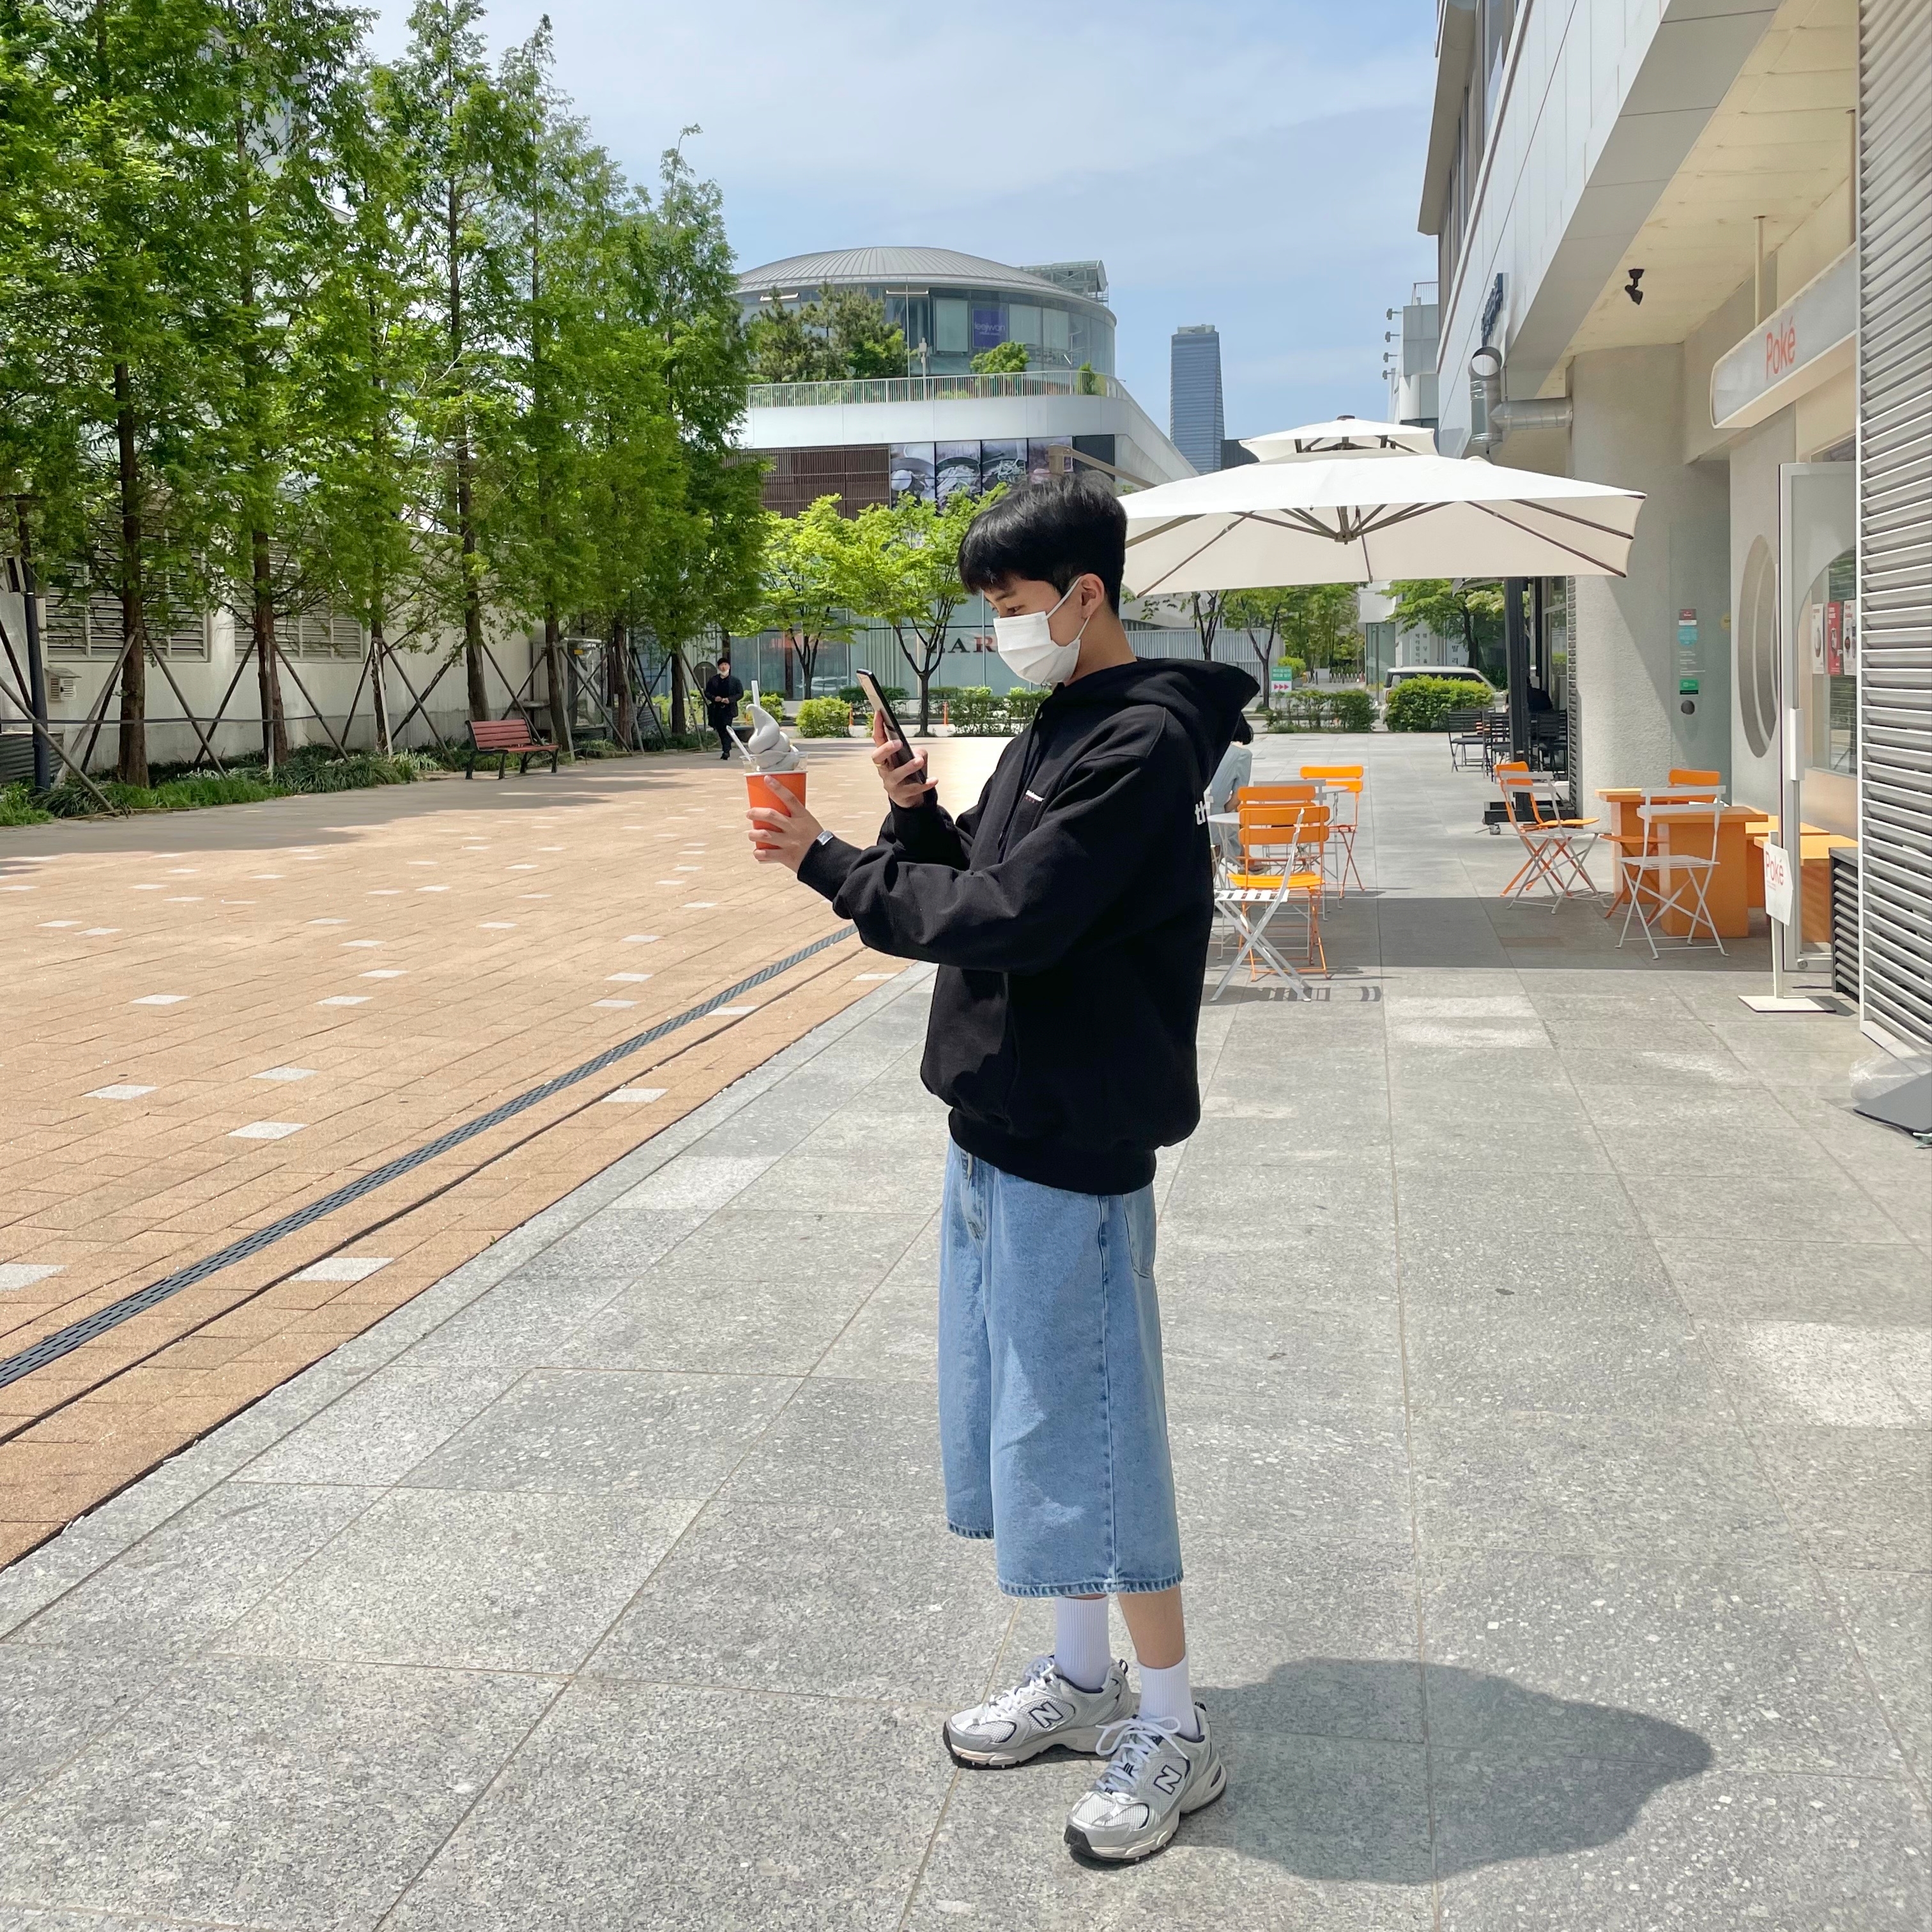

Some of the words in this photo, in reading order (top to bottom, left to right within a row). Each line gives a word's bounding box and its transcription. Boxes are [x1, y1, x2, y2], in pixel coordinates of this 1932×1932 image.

[1766, 315, 1795, 380] Poké
[1765, 851, 1784, 886] Poké
[1029, 1701, 1064, 1728] N
[1153, 1764, 1182, 1795] N
